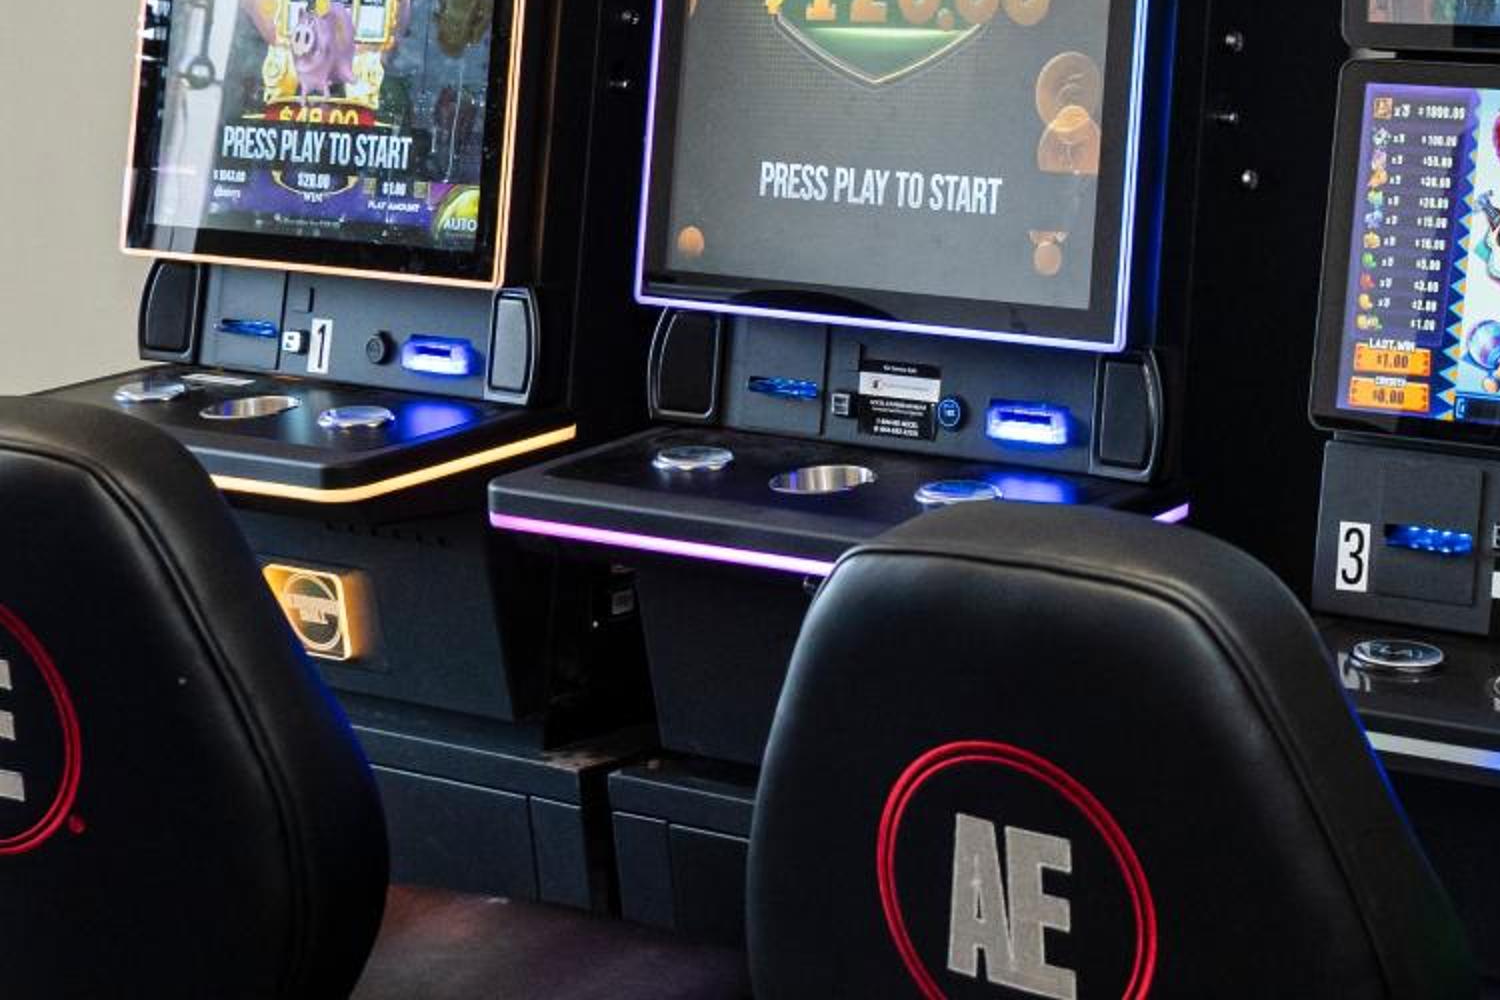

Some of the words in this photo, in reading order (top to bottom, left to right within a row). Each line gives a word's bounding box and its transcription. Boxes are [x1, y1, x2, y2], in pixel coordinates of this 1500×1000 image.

[222, 125, 277, 160] PRESS
[280, 128, 326, 164] PLAY
[329, 132, 350, 166] TO
[354, 134, 413, 170] START
[759, 162, 829, 201] PRESS
[832, 166, 891, 205] PLAY
[895, 170, 925, 209] TO
[929, 174, 1002, 214] START
[443, 217, 478, 231] AUTO
[1340, 527, 1365, 586] 3
[947, 812, 1077, 1000] AE
